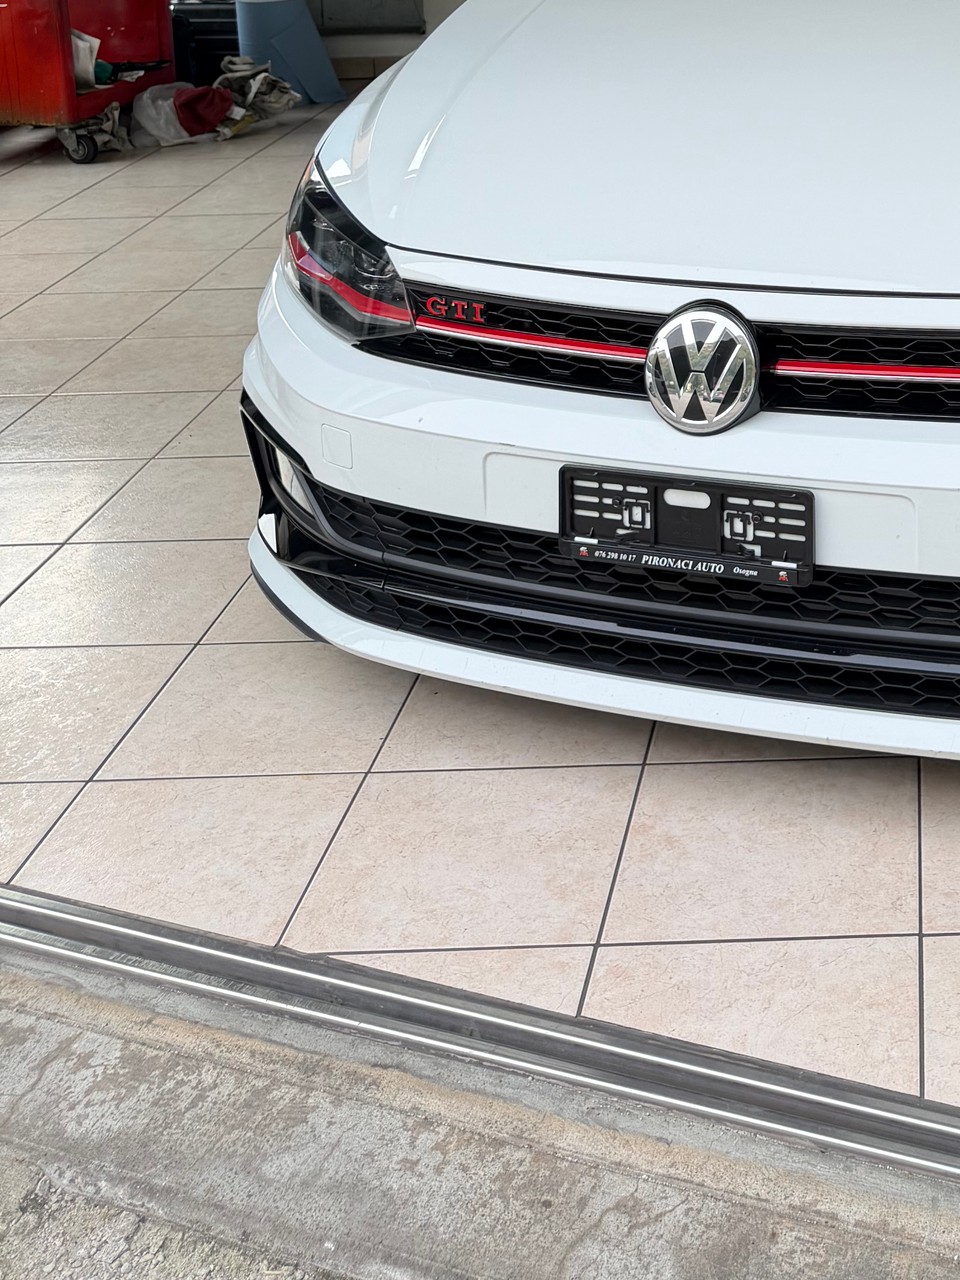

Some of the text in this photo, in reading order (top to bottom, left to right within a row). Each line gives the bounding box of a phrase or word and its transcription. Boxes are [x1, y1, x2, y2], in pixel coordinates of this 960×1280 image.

[425, 296, 486, 324] GTI
[653, 308, 752, 429] VW
[594, 550, 758, 577] 076 298 10 17 PIRONACI AUTO Osogna
